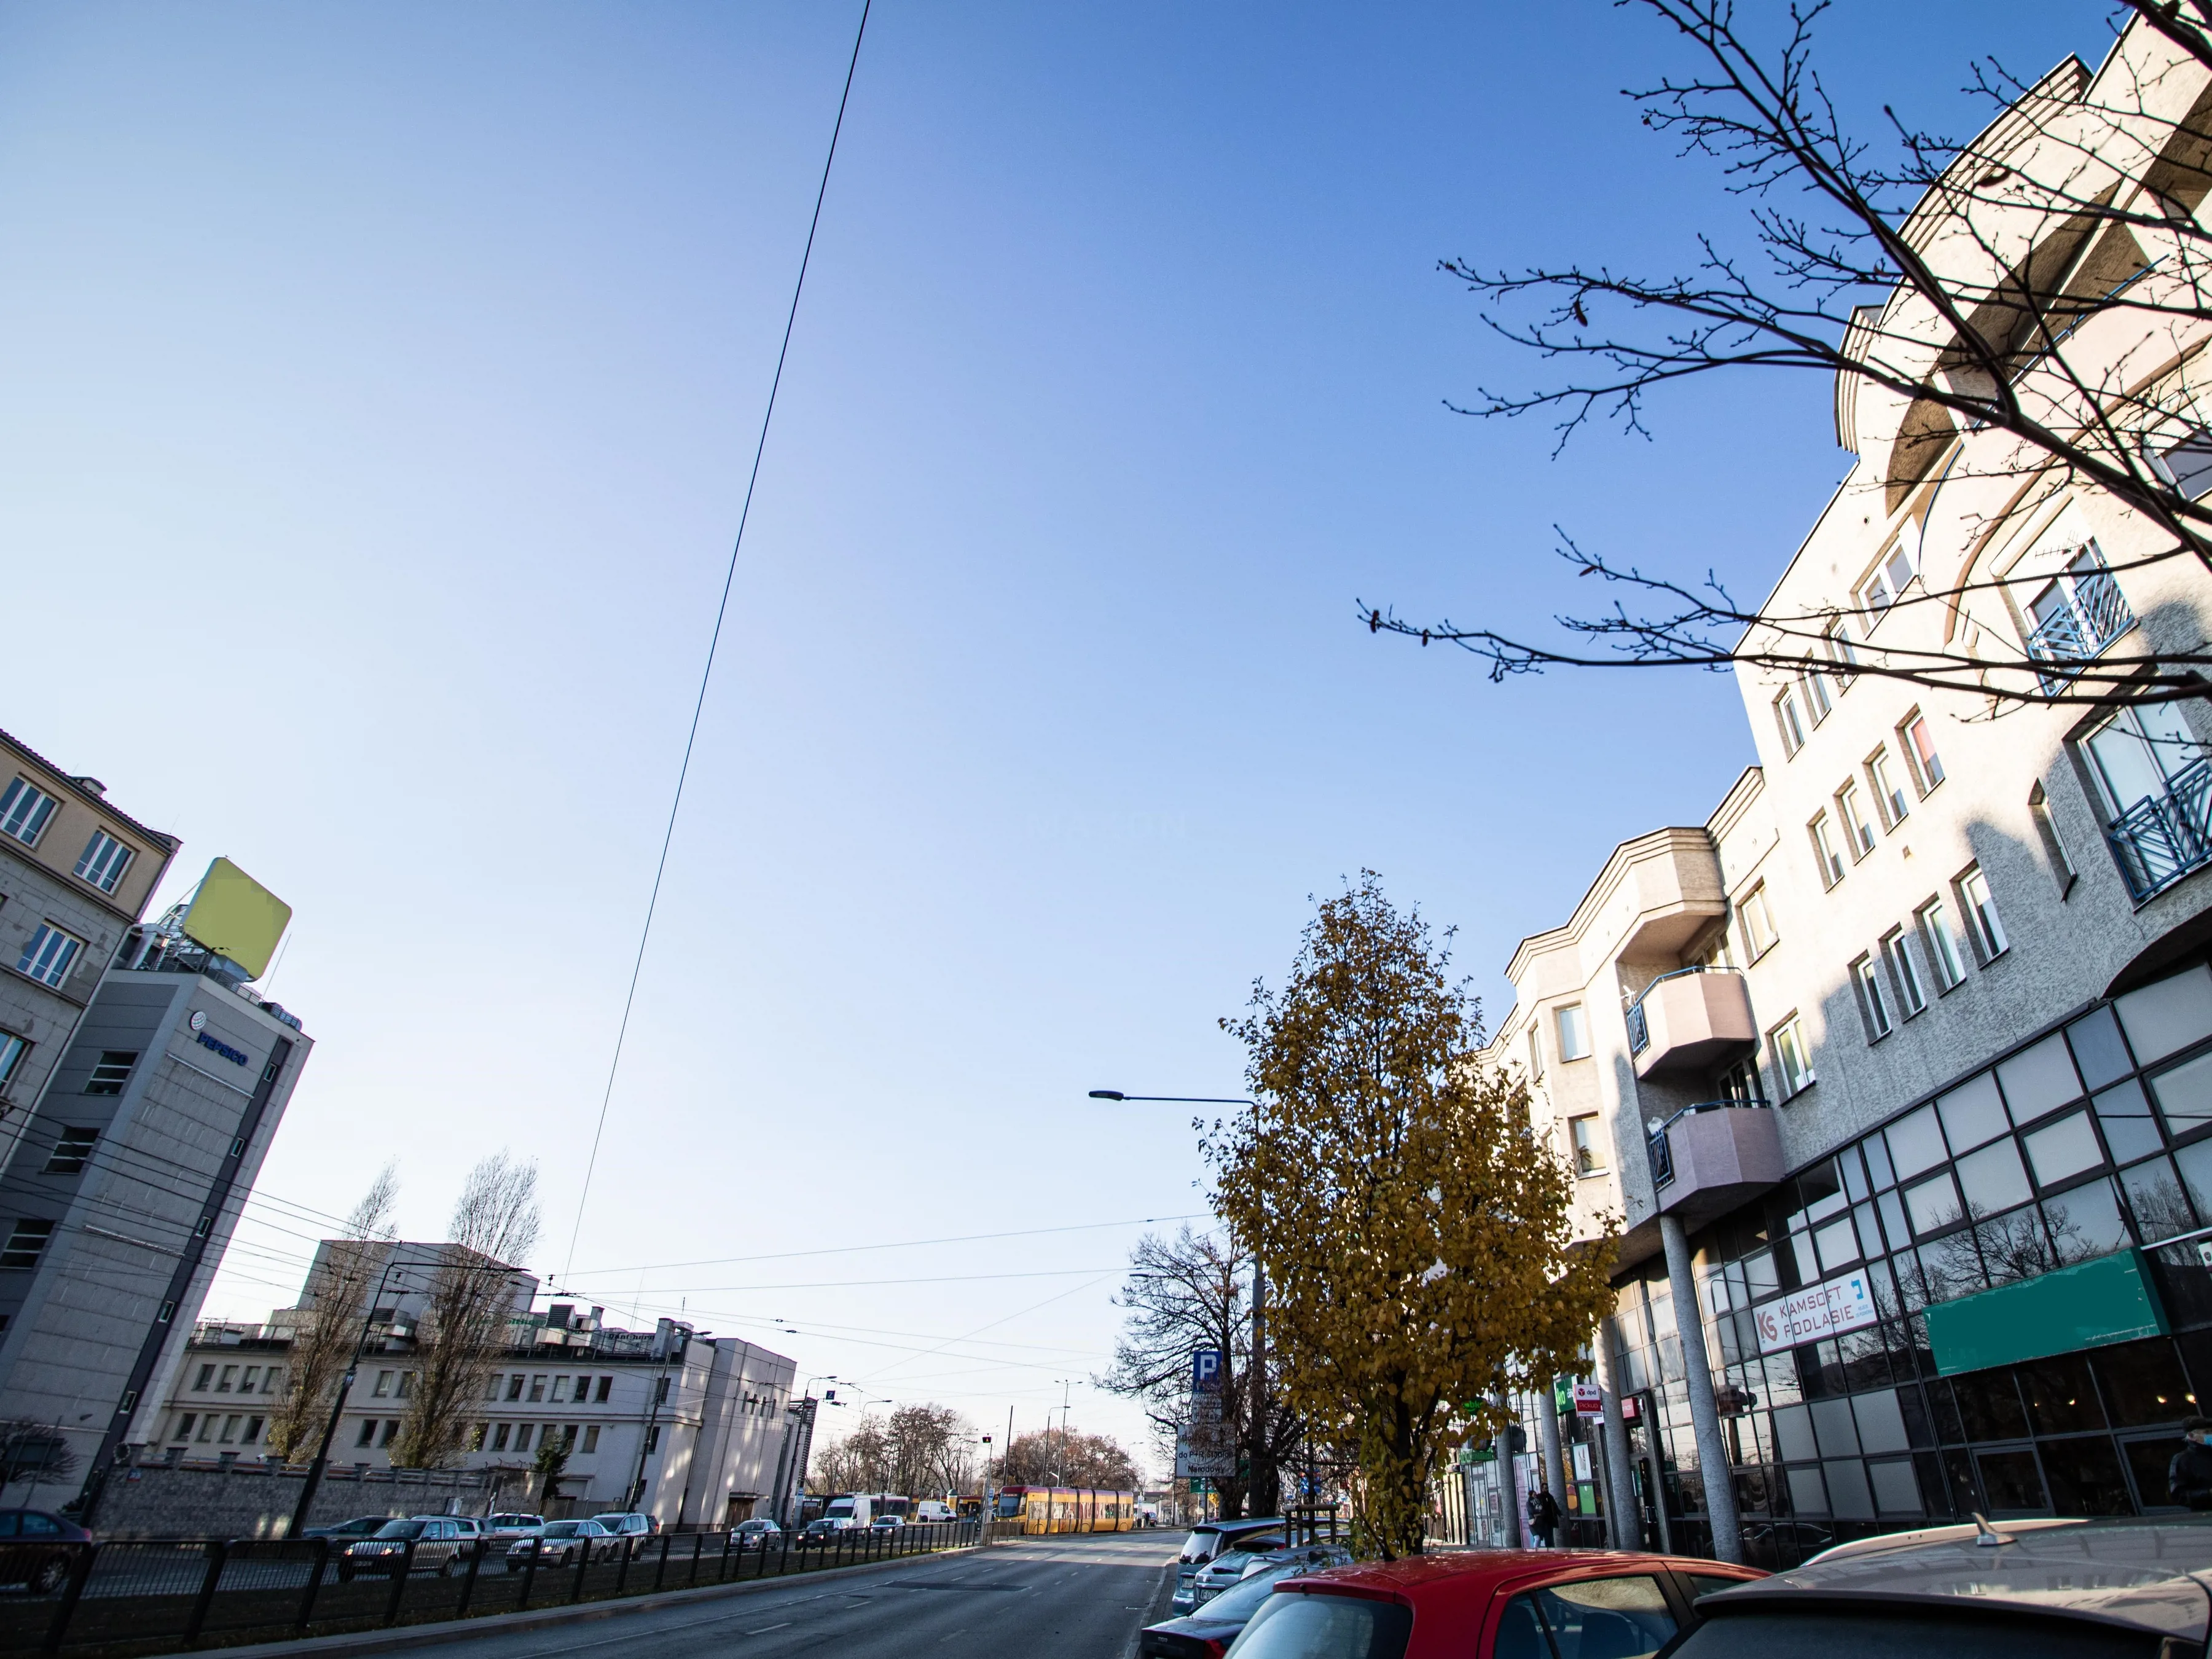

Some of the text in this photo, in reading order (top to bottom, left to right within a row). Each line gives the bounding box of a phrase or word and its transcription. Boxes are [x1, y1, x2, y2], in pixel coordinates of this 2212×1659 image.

[197, 1032, 249, 1066] PEPSICO
[1779, 1285, 1841, 1319] KAMSOFT
[1200, 1354, 1217, 1381] P
[1188, 1465, 1225, 1473] Narodowy
